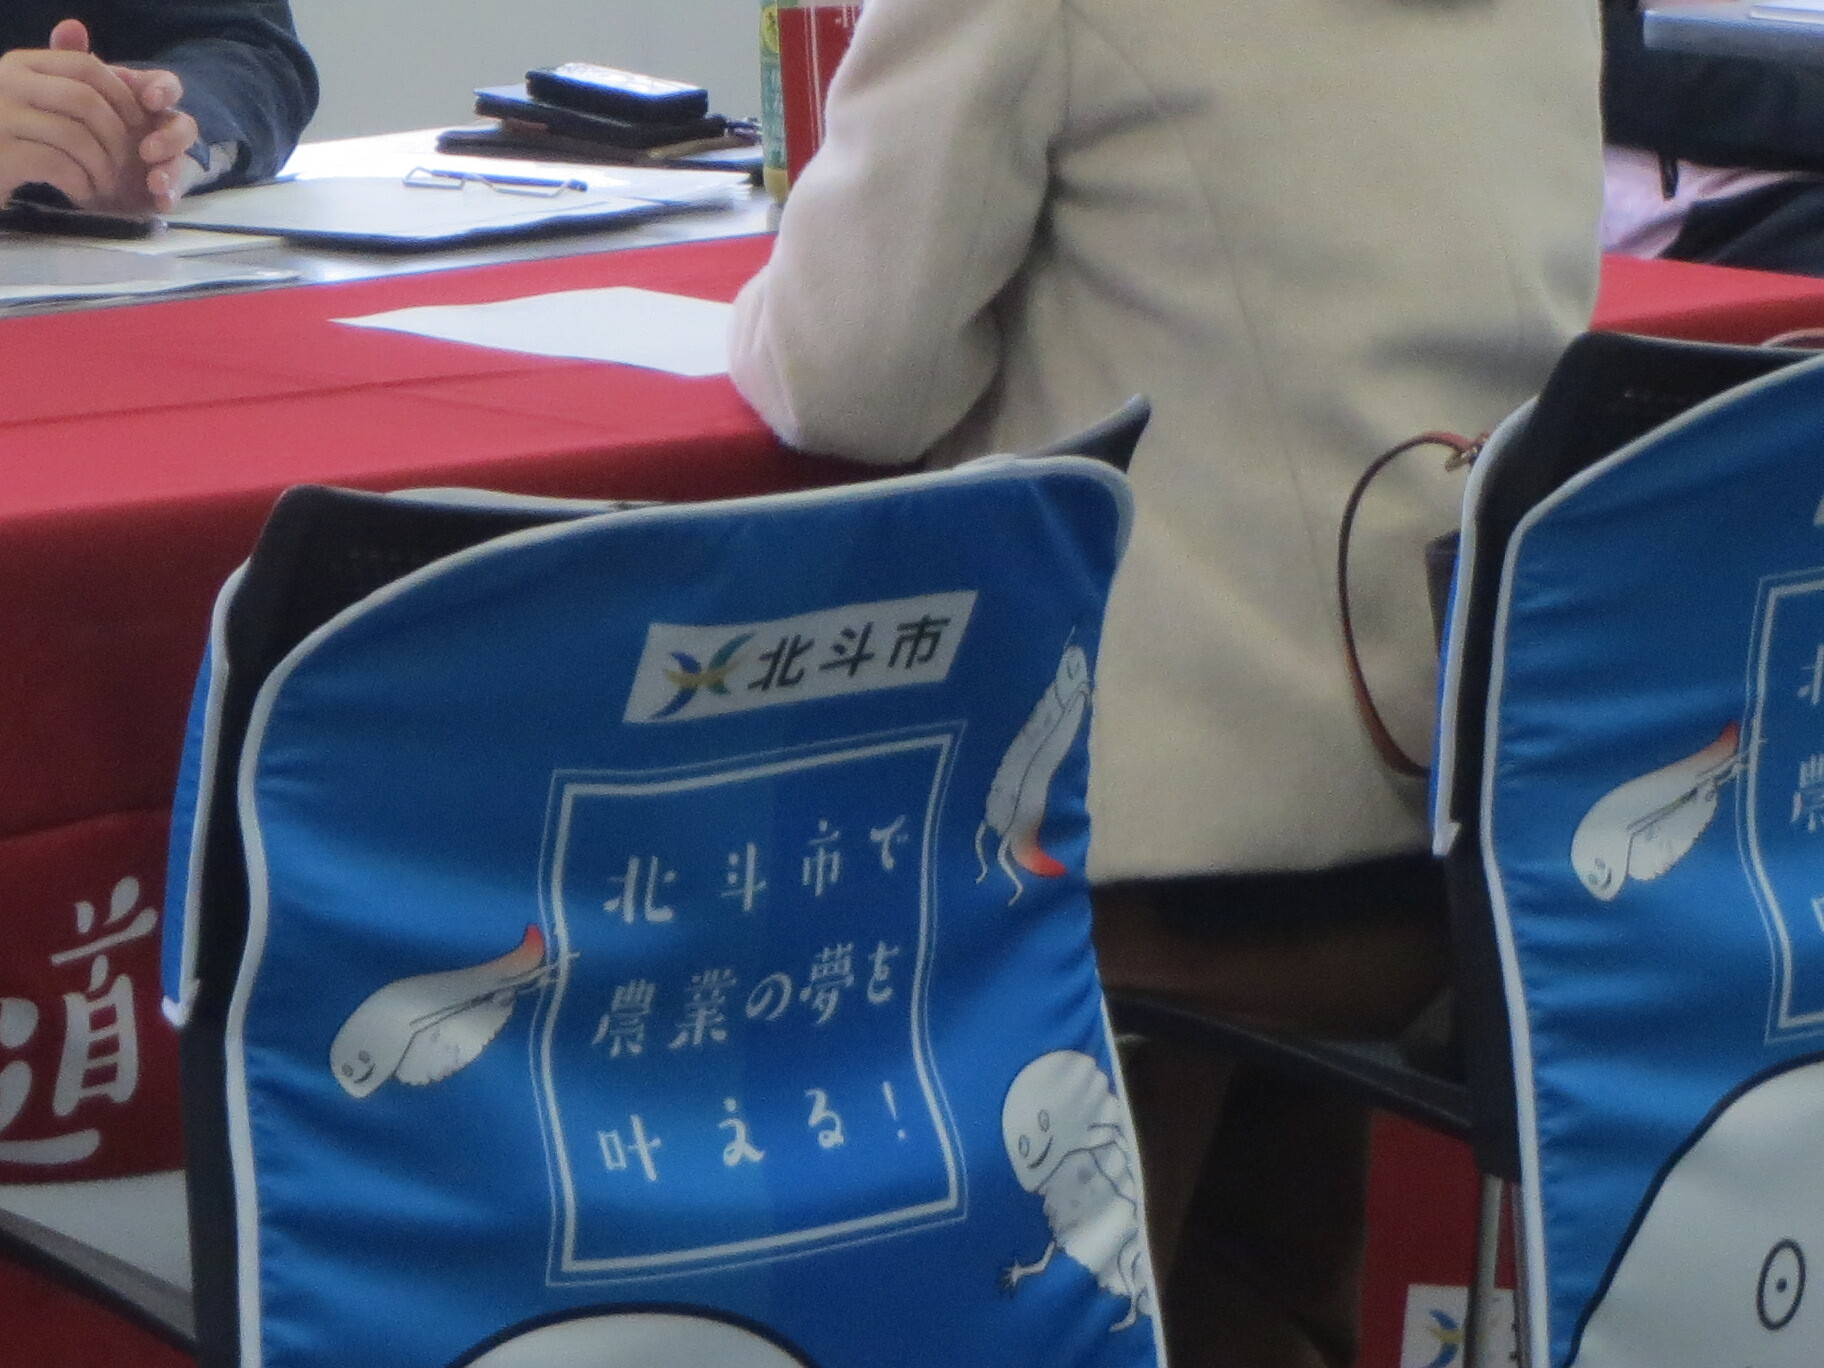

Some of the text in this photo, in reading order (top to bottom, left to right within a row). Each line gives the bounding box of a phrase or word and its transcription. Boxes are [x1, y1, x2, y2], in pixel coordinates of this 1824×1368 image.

[745, 613, 952, 693] 北斗市
[602, 815, 911, 925] 北斗市で
[591, 939, 901, 1058] 農業の夢を
